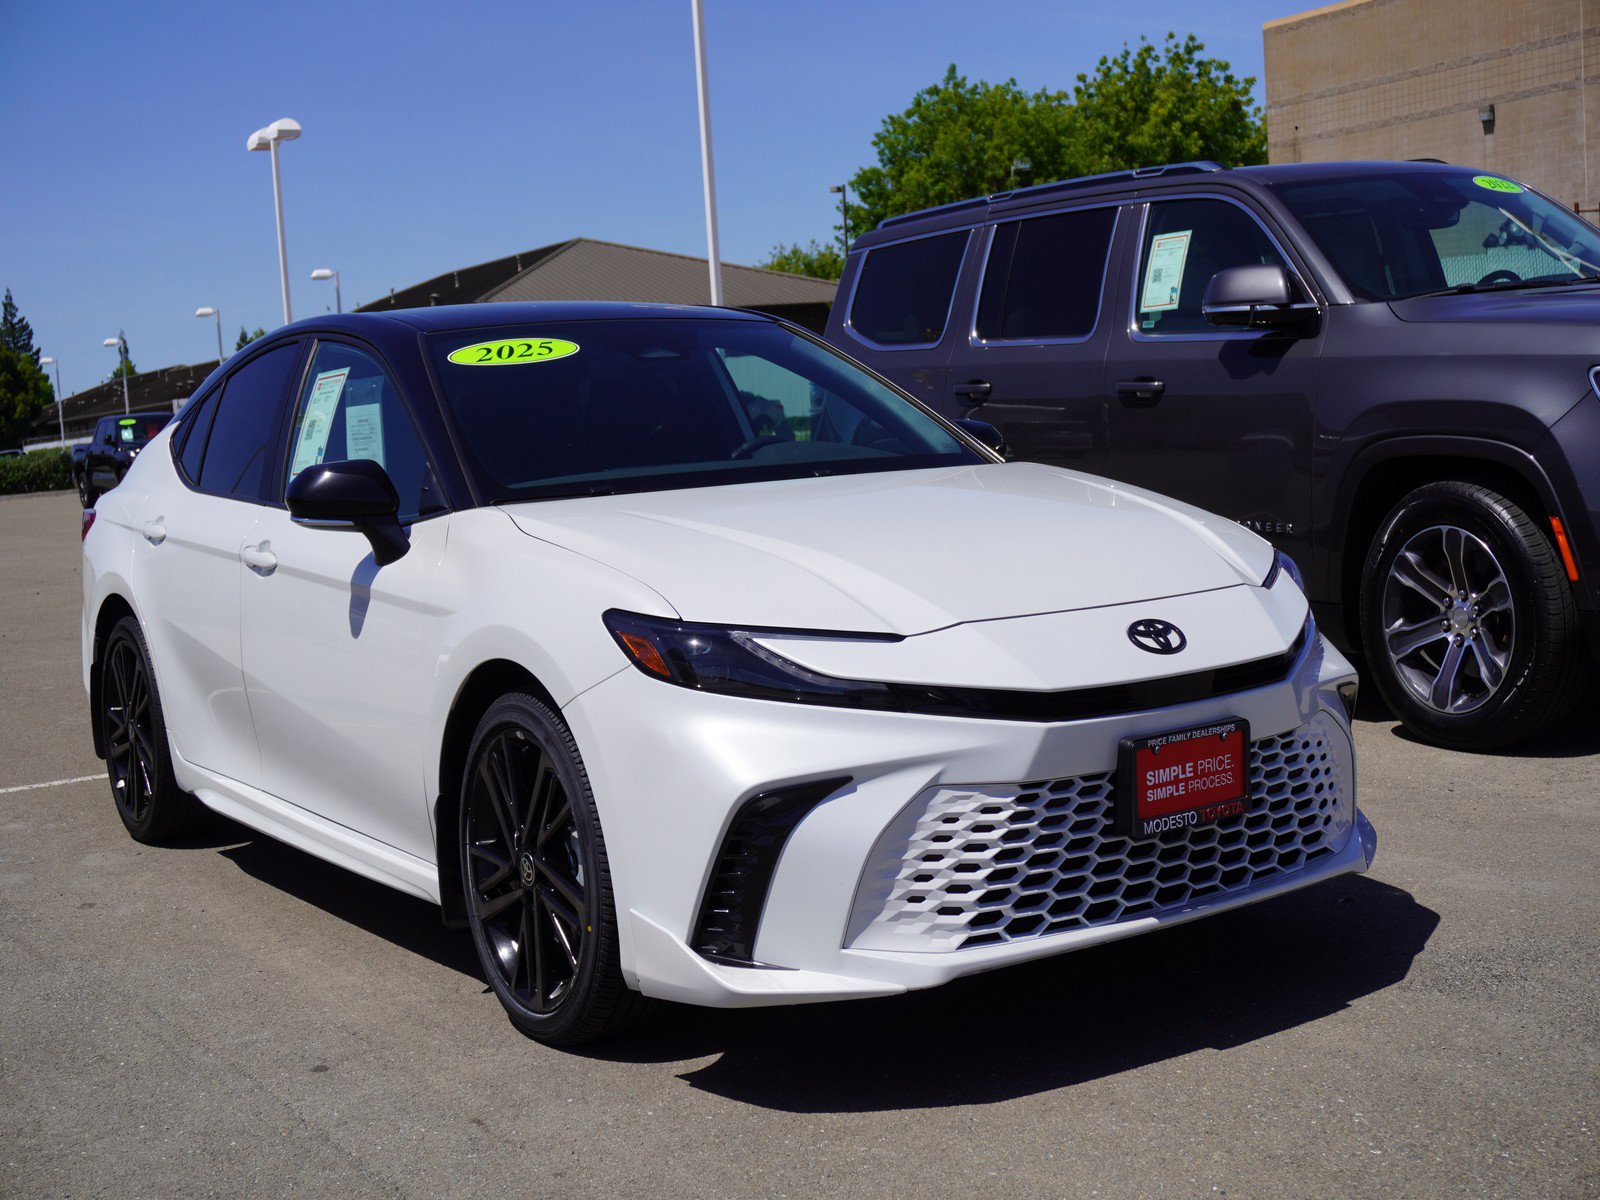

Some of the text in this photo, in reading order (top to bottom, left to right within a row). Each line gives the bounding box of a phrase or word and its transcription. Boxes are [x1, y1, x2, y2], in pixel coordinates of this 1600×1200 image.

[475, 341, 553, 363] 2025
[1147, 724, 1236, 748] PRICE FAMILY DEALERSHIPS
[1146, 754, 1235, 786] SIMPLE PRICE.
[1146, 772, 1235, 802] SIMPLE PROCESS.
[1144, 801, 1245, 835] MODESTO TOYOTA
